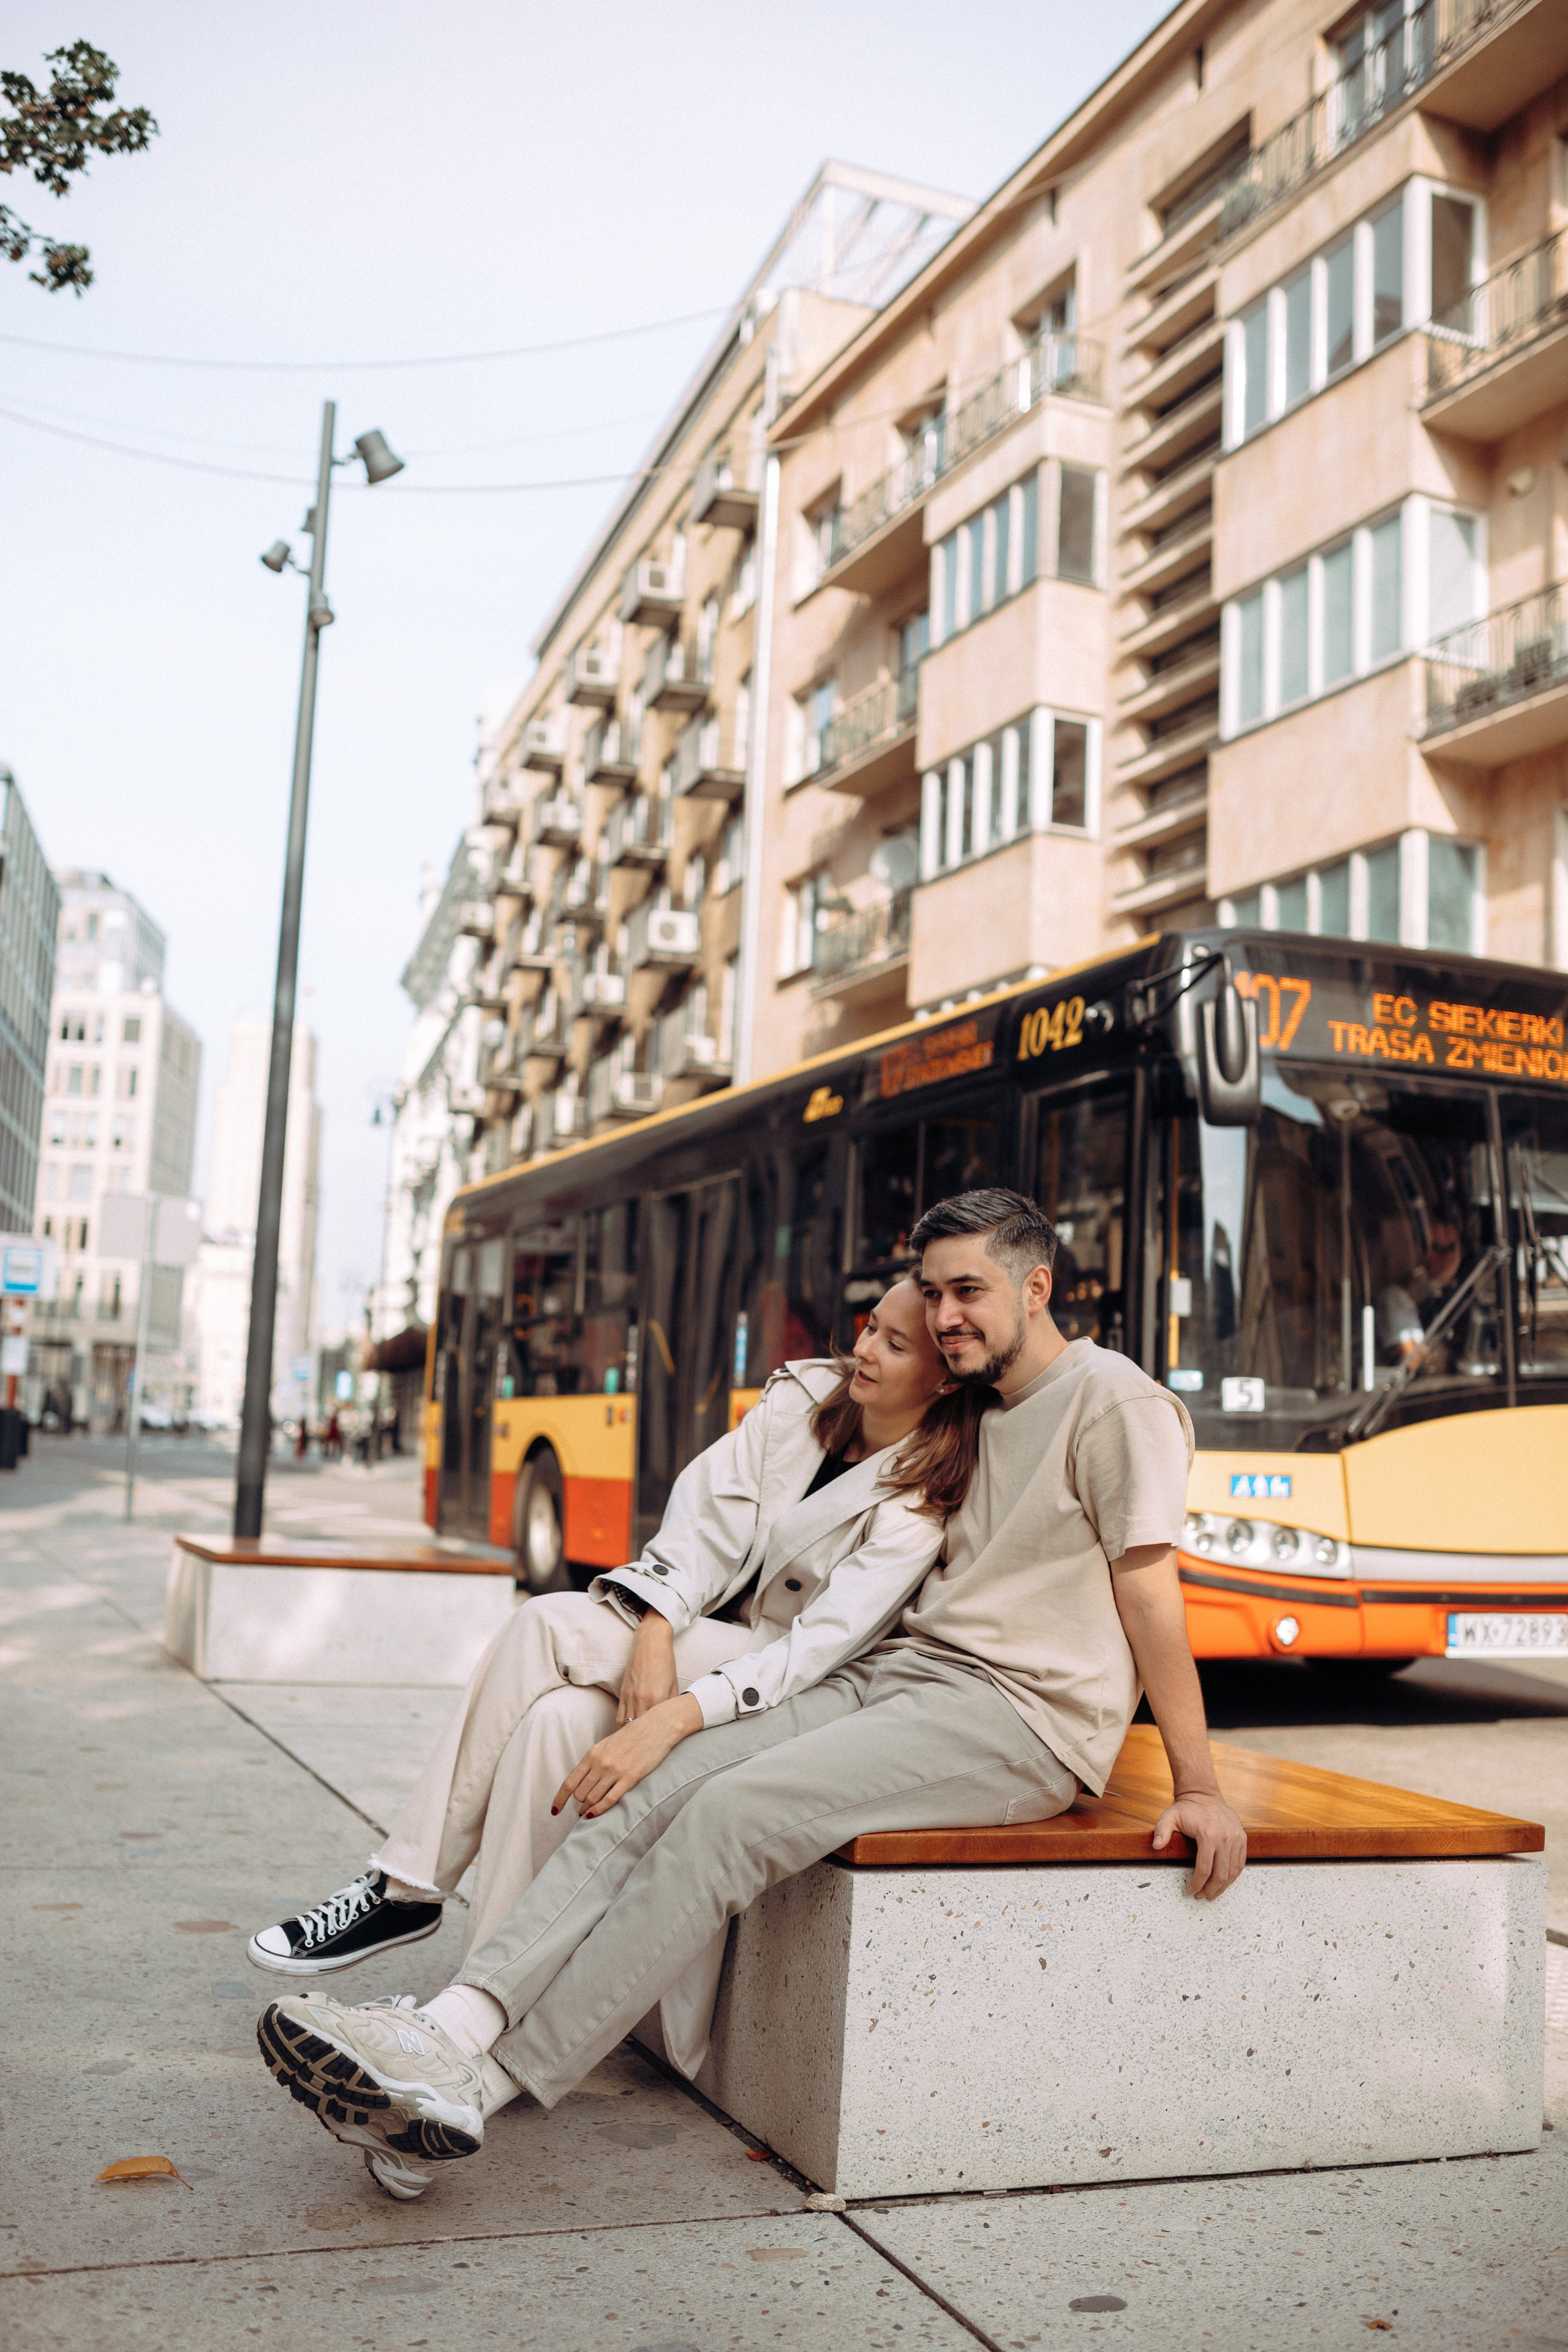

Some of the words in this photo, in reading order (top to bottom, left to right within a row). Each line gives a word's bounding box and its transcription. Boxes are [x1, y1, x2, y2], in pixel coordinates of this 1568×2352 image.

[1017, 995, 1085, 1061] 1042
[1327, 1020, 1435, 1064] TRASA
[1372, 992, 1417, 1027] EC
[1428, 1001, 1564, 1048] SIEKIERKI
[1238, 1378, 1253, 1408] 5
[396, 2029, 425, 2056] N
